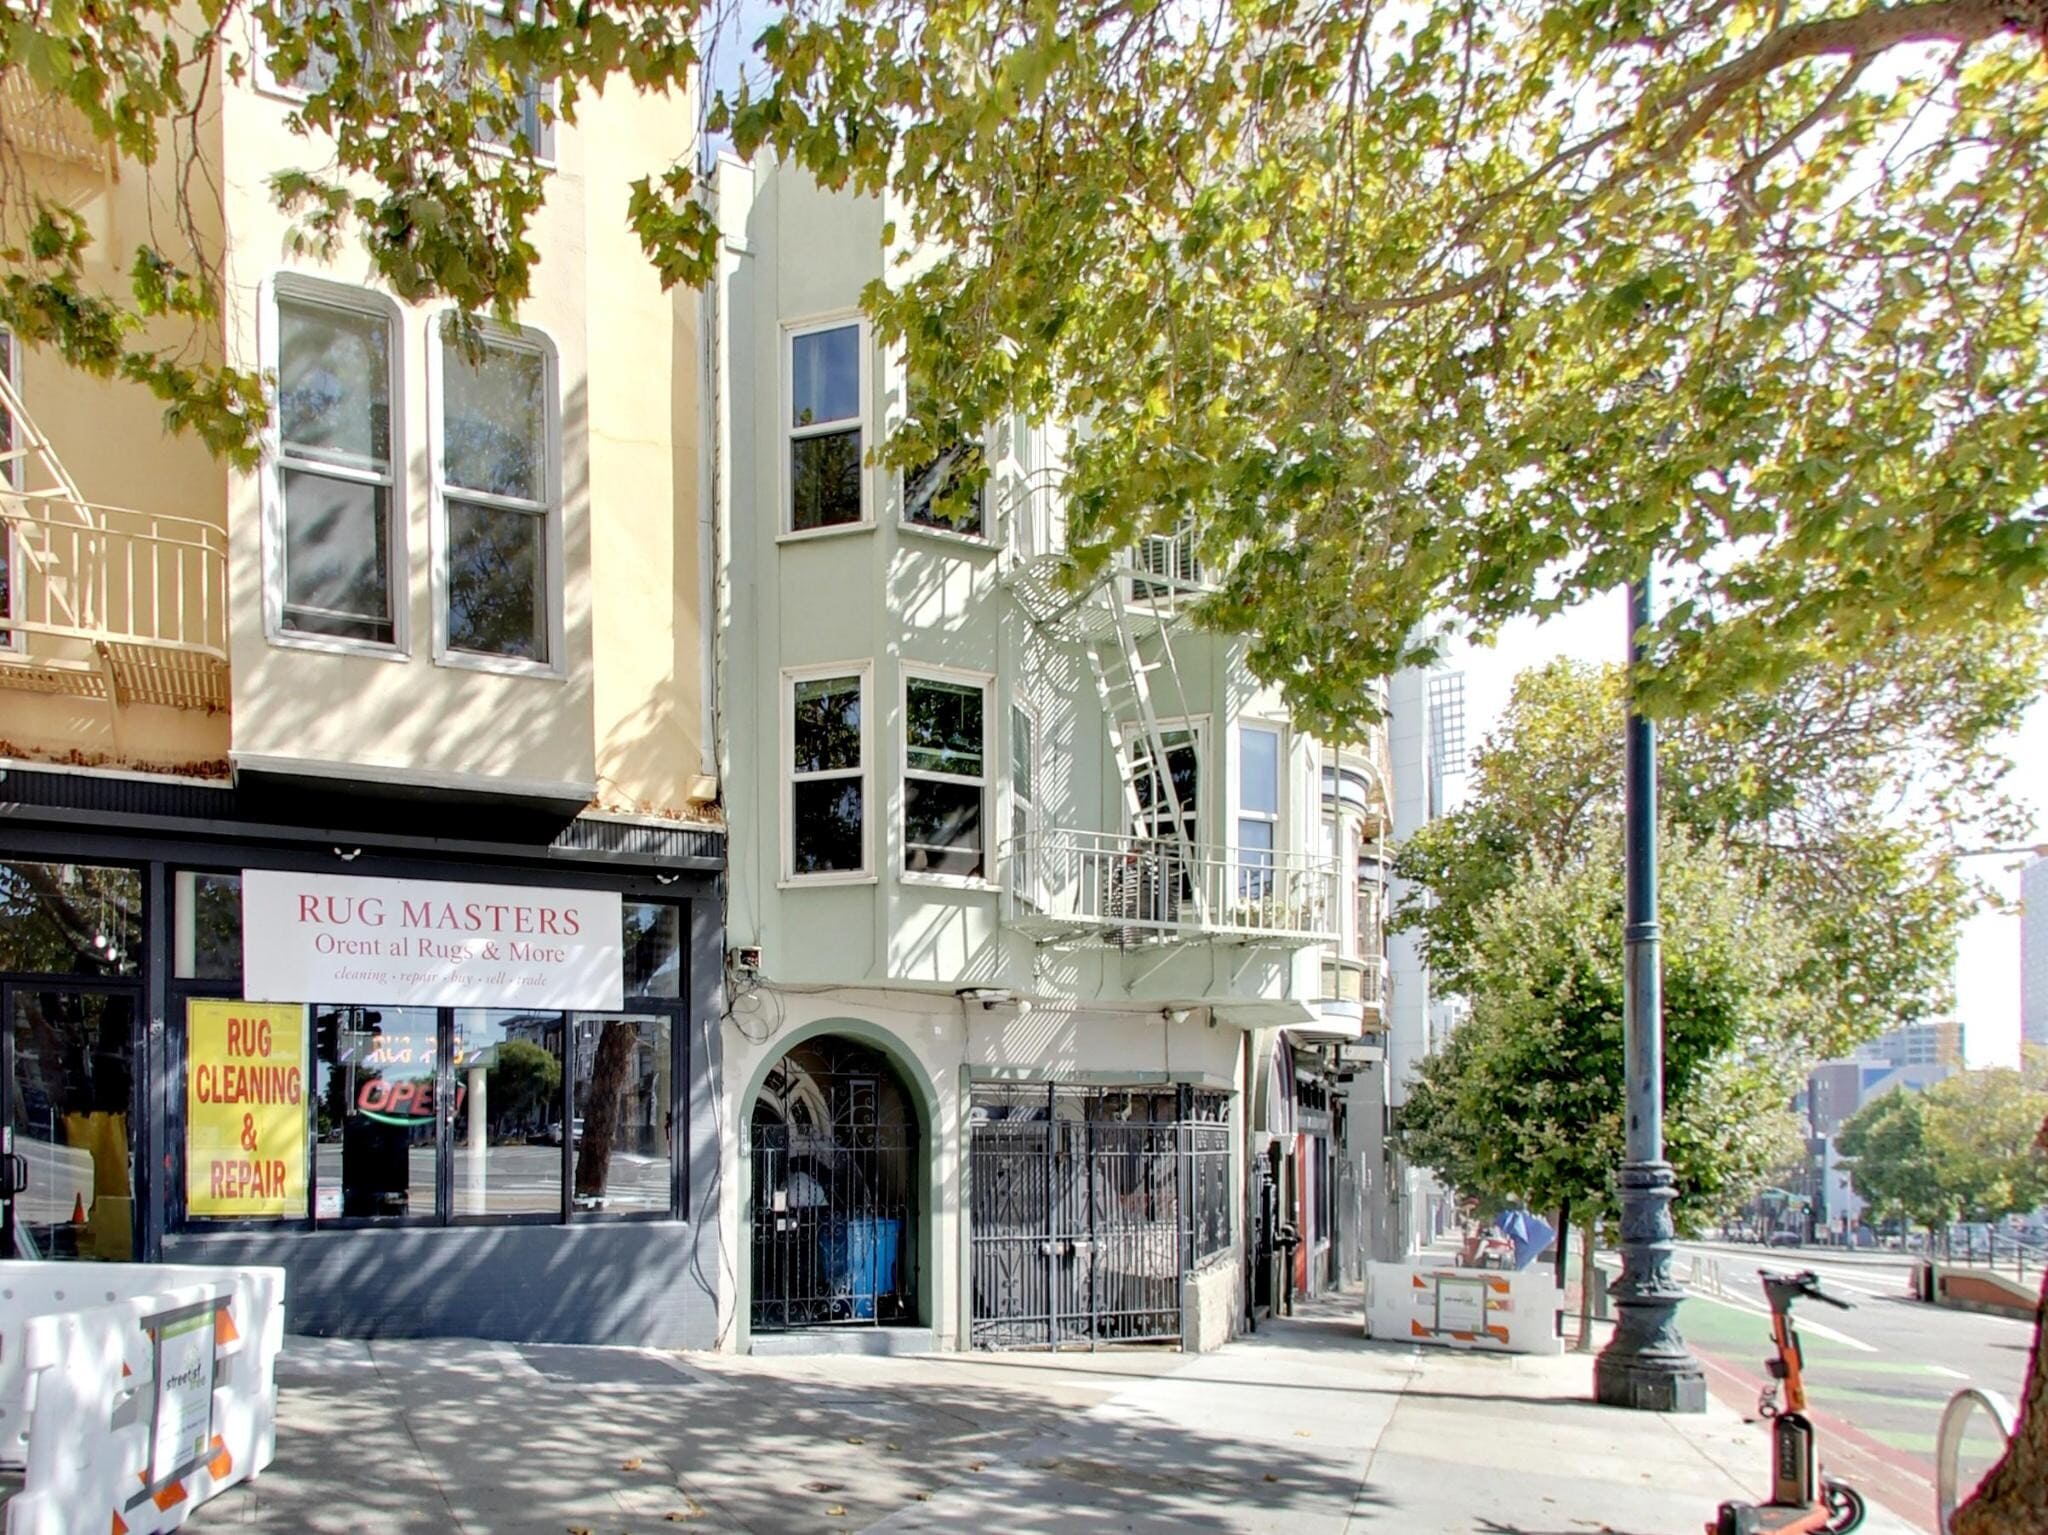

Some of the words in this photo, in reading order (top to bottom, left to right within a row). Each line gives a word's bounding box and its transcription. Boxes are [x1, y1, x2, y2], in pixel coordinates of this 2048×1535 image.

[298, 893, 386, 927] RUG
[401, 900, 580, 936] MASTERS
[418, 938, 473, 964] Rugs
[481, 940, 500, 960] &
[509, 942, 566, 963] More
[334, 966, 388, 984] cleaning
[400, 971, 438, 985] repair
[448, 969, 473, 988] buy
[227, 1017, 272, 1057] RUG
[196, 1064, 301, 1105] CLEANING
[240, 1112, 258, 1152] &
[210, 1160, 286, 1199] REPAIR
